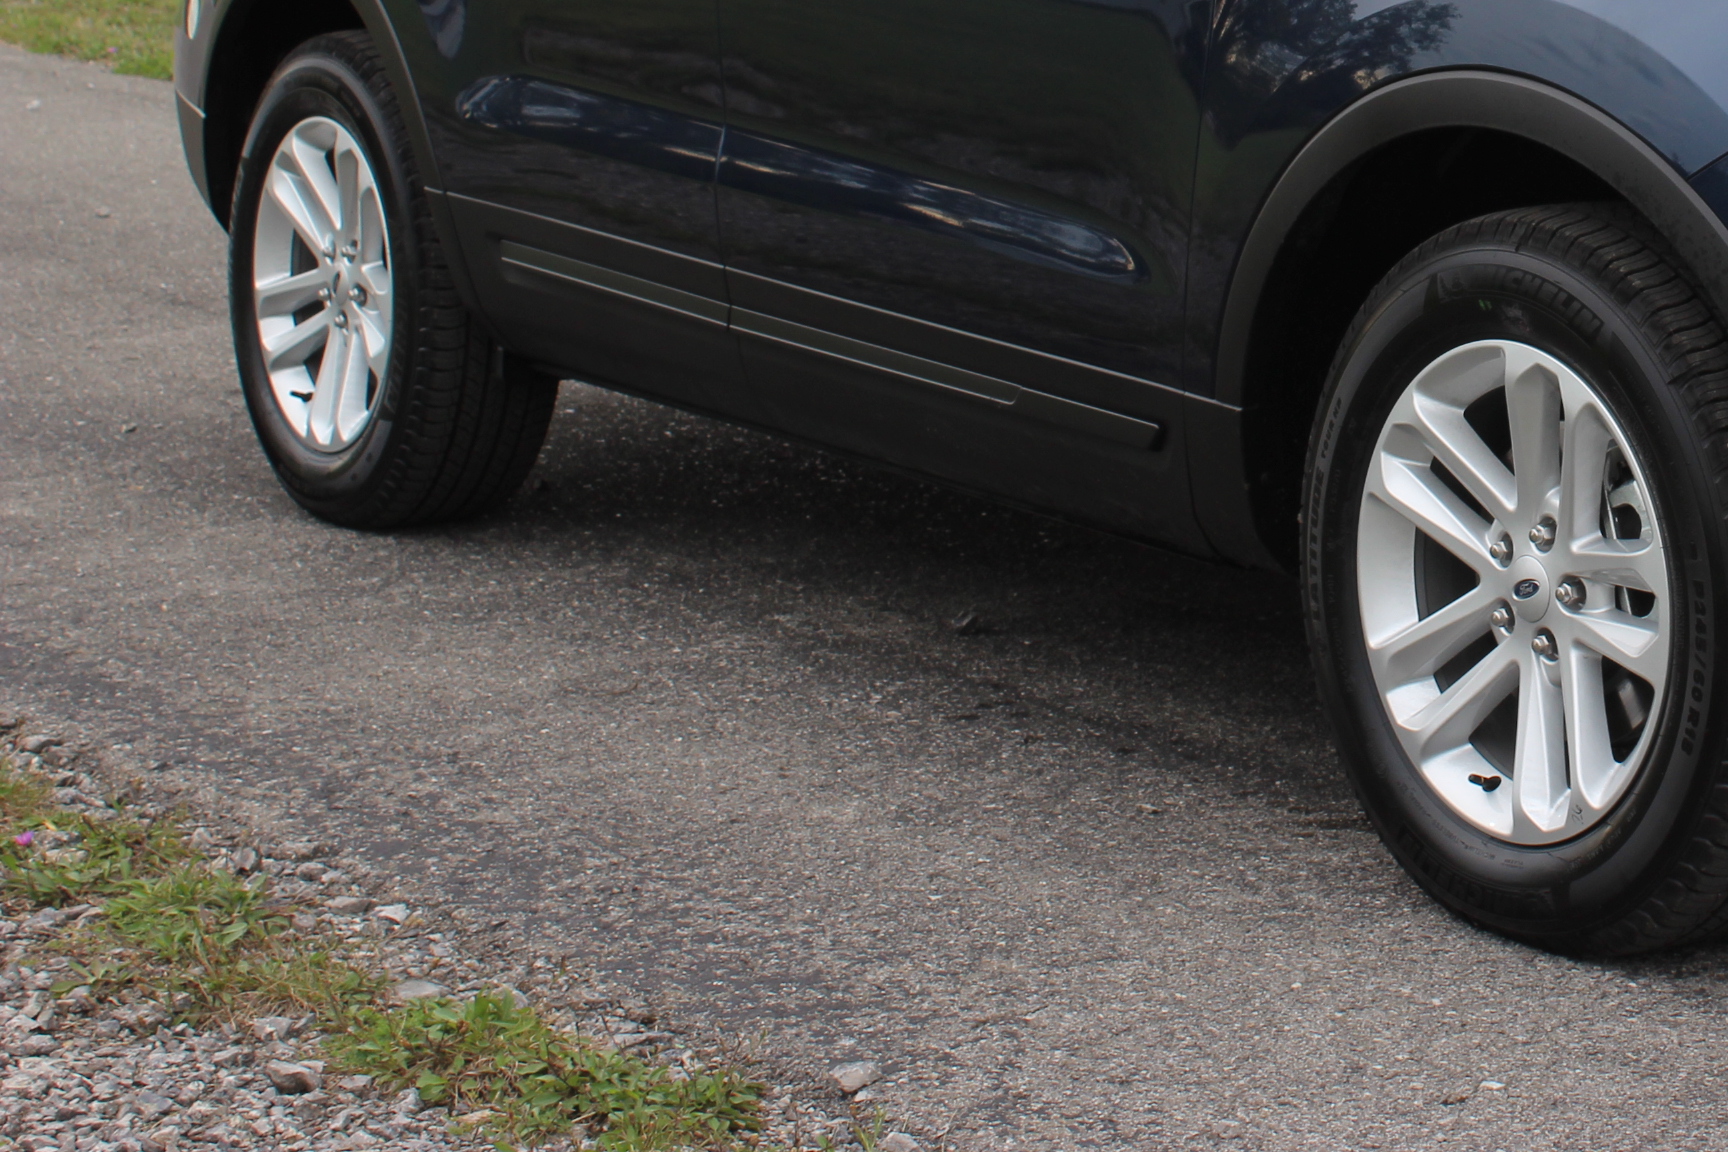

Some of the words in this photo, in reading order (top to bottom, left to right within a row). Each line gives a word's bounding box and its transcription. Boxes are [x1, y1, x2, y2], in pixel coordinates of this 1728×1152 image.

[1470, 263, 1605, 335] MICHELIN
[1310, 465, 1324, 621] LATITUDE
[1320, 419, 1335, 459] TOUR
[1332, 396, 1342, 420] HP
[1690, 579, 1708, 703] P245/60
[1680, 706, 1701, 757] R18
